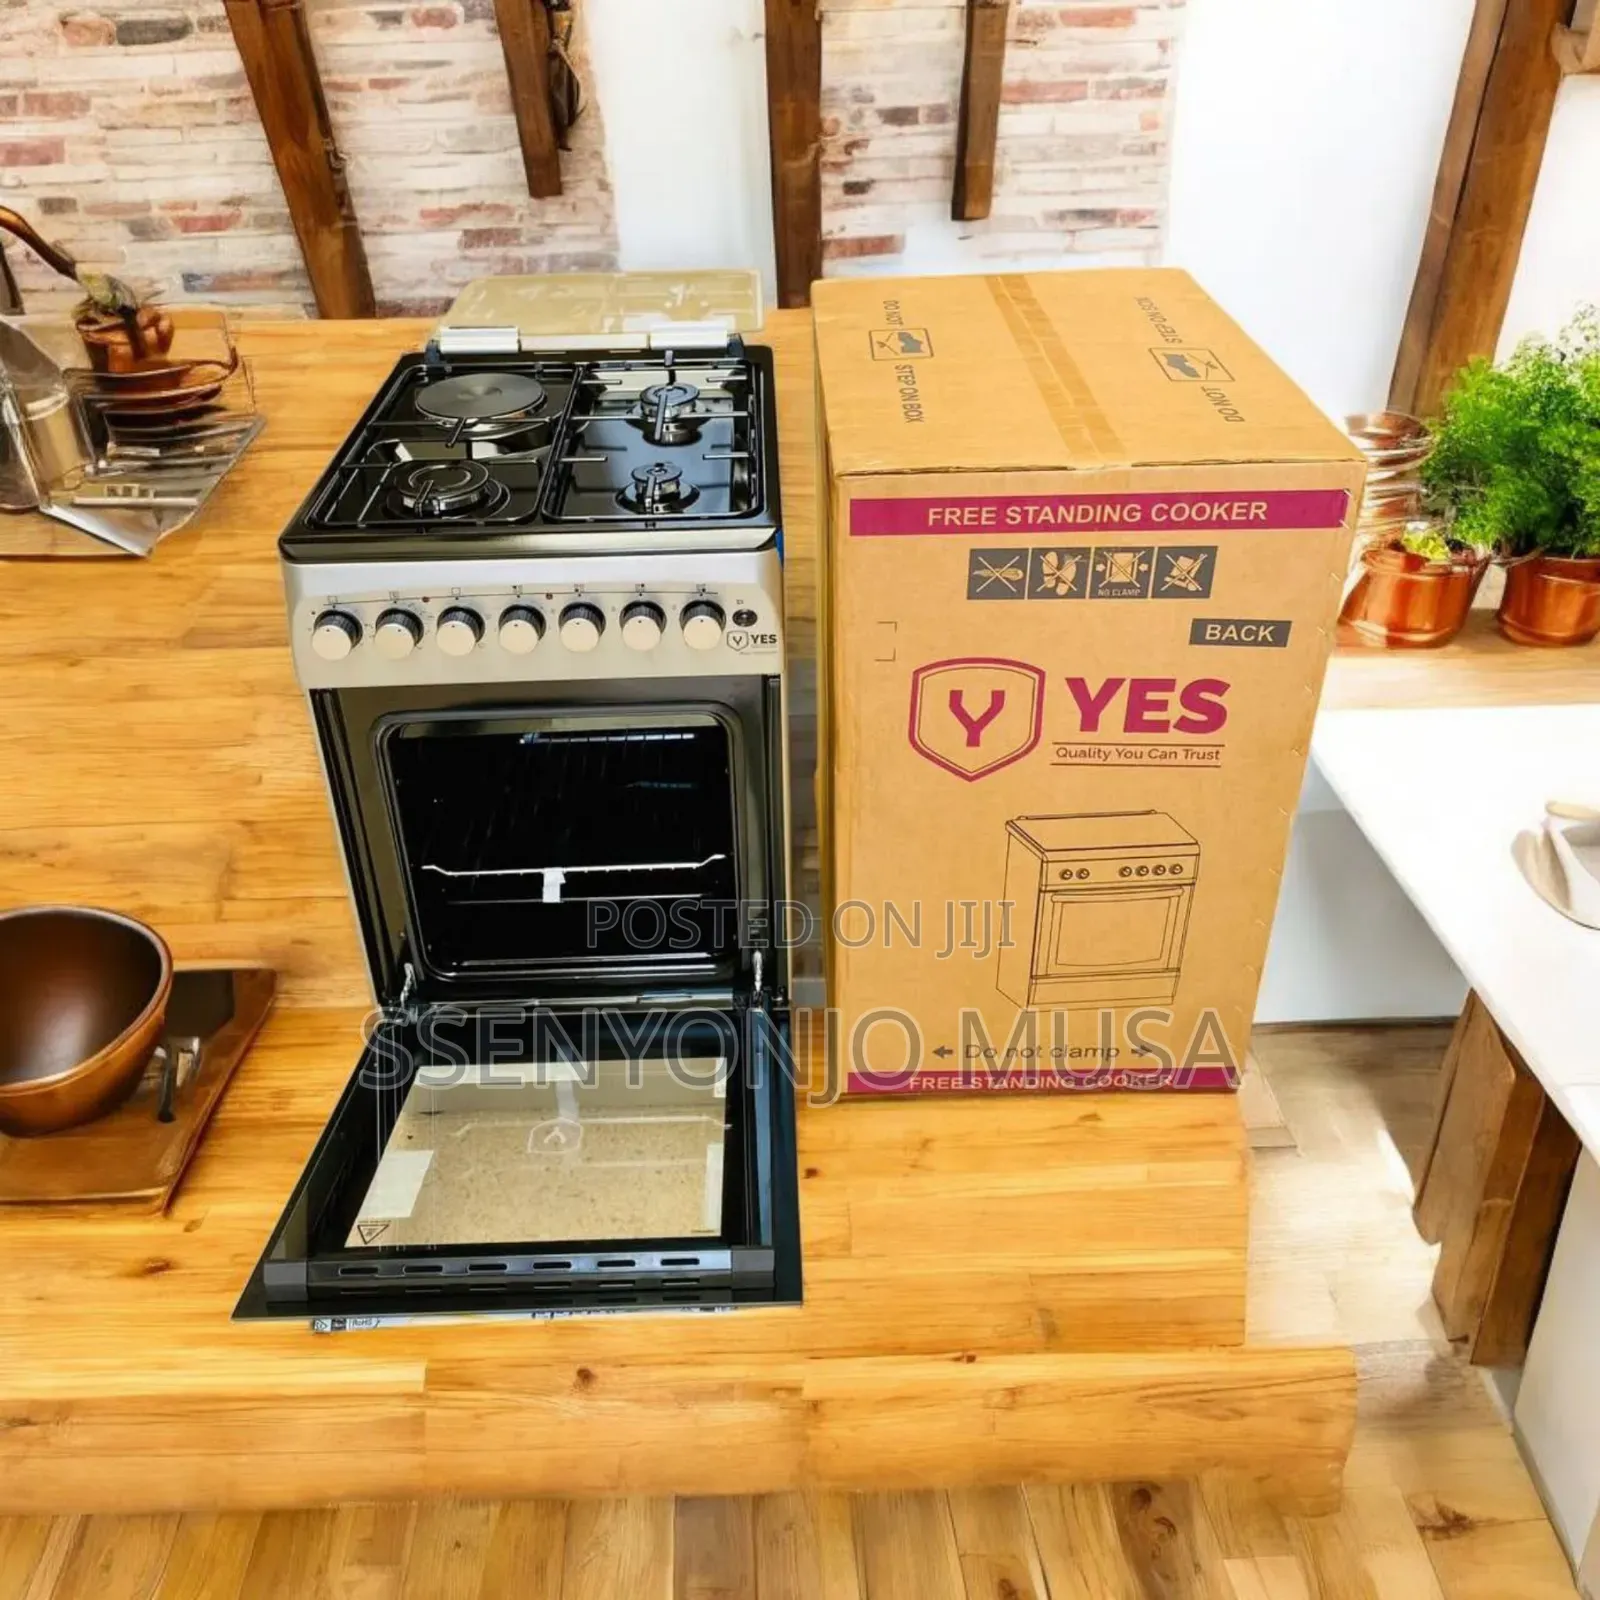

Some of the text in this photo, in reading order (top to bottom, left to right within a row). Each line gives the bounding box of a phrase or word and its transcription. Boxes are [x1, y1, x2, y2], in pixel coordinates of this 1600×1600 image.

[883, 300, 904, 326] DO NOT
[1153, 323, 1183, 344] STEP
[895, 364, 924, 423] STEP ON BOX
[1200, 386, 1245, 422] DO NOT
[928, 501, 1268, 526] FREE STANDING COOKER
[750, 634, 777, 645] YES
[1205, 623, 1275, 643] BACK
[1065, 677, 1231, 734] YES
[949, 689, 1006, 747] Y
[1056, 747, 1220, 762] Quality You Can Trust
[965, 1044, 1120, 1062] Do not clamp
[909, 1074, 1174, 1090] FREE STANDING COOKER
